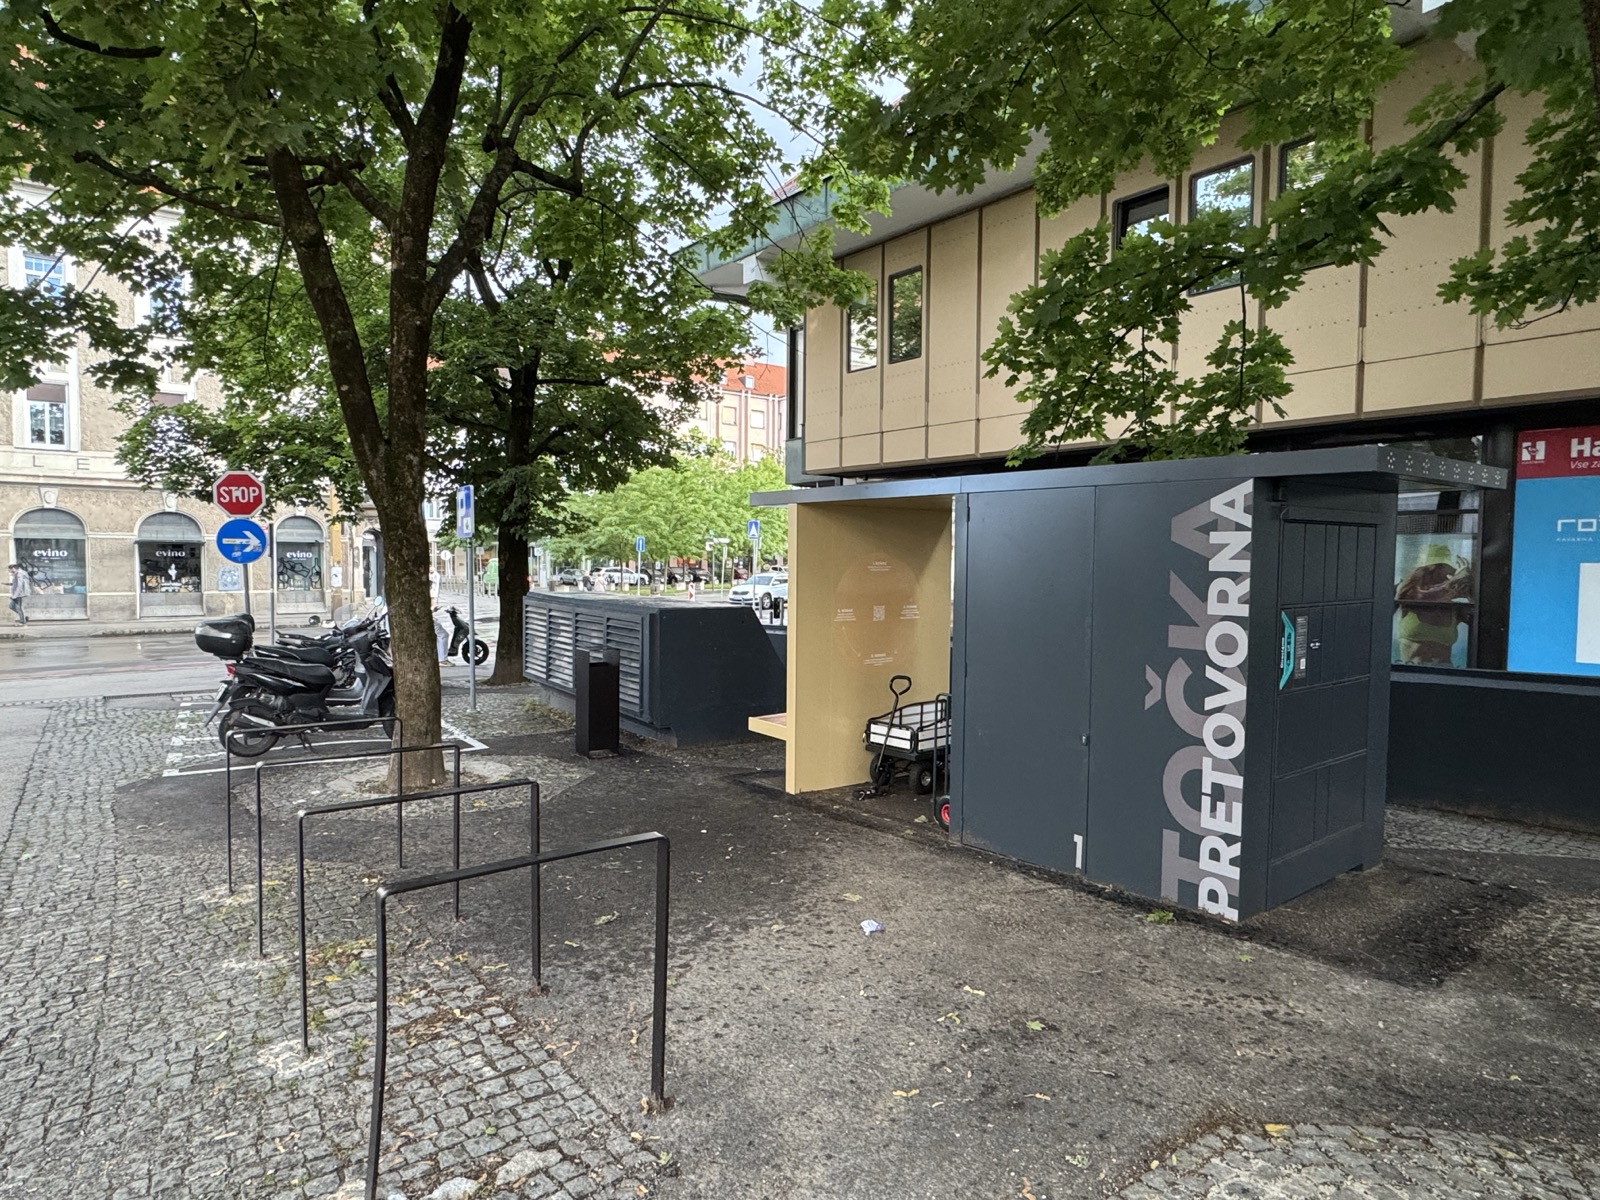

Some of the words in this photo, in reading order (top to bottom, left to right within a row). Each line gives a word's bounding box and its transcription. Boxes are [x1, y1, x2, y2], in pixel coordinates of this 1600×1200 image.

[1570, 461, 1589, 469] Vse
[219, 486, 260, 503] STOP
[33, 548, 68, 557] evino
[155, 549, 186, 557] evino
[286, 550, 313, 559] evino
[1144, 485, 1252, 903] TOČKA
[1198, 478, 1254, 922] PRETOVORNA
